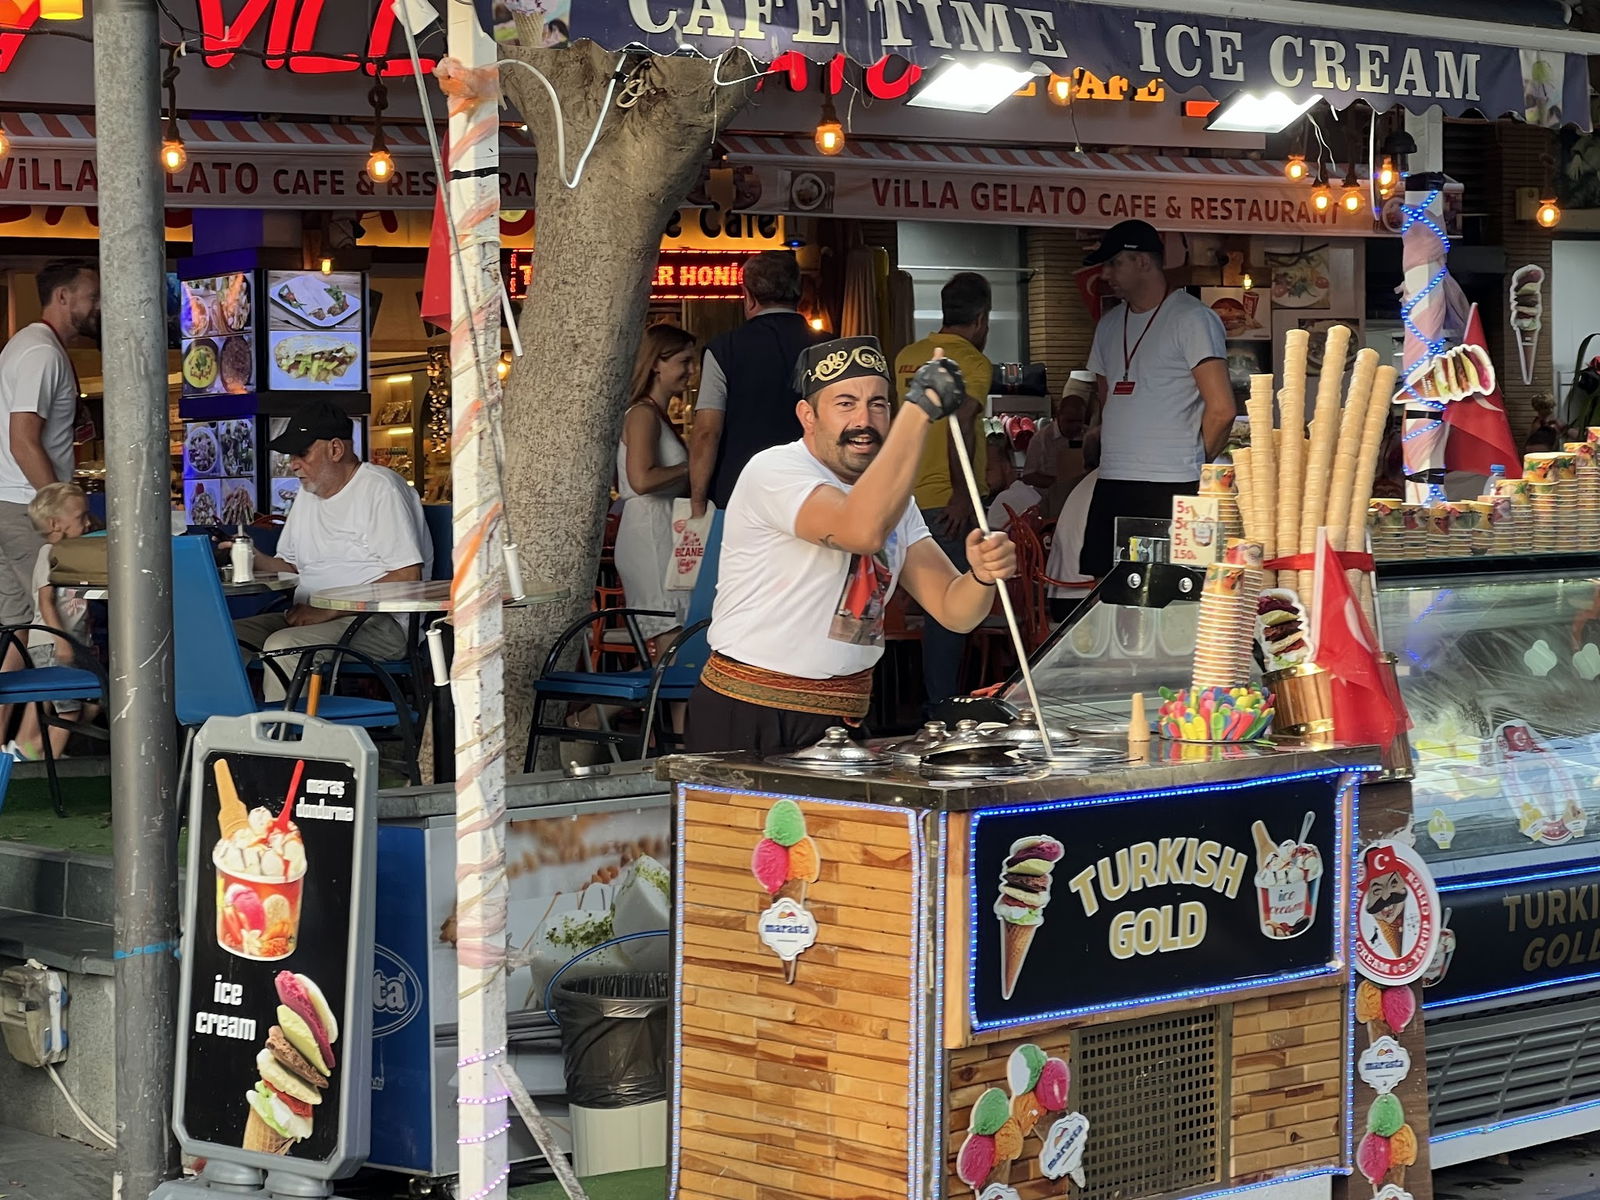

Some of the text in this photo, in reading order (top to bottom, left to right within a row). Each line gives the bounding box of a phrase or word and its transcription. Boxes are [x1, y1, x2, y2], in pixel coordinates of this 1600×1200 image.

[629, 0, 1069, 59] CAFE TIME
[1134, 20, 1482, 102] ICE CREAM
[165, 161, 260, 195] LATO
[272, 168, 345, 196] CAFE
[355, 170, 376, 197] &
[970, 181, 1087, 216] GELATO
[1097, 192, 1157, 218] CAFE
[1164, 195, 1182, 219] &
[1068, 836, 1249, 918] TURKISH
[1108, 900, 1208, 961] GOLD
[1502, 883, 1600, 932] TURKI
[213, 974, 243, 1006] ice
[195, 1011, 257, 1042] cream
